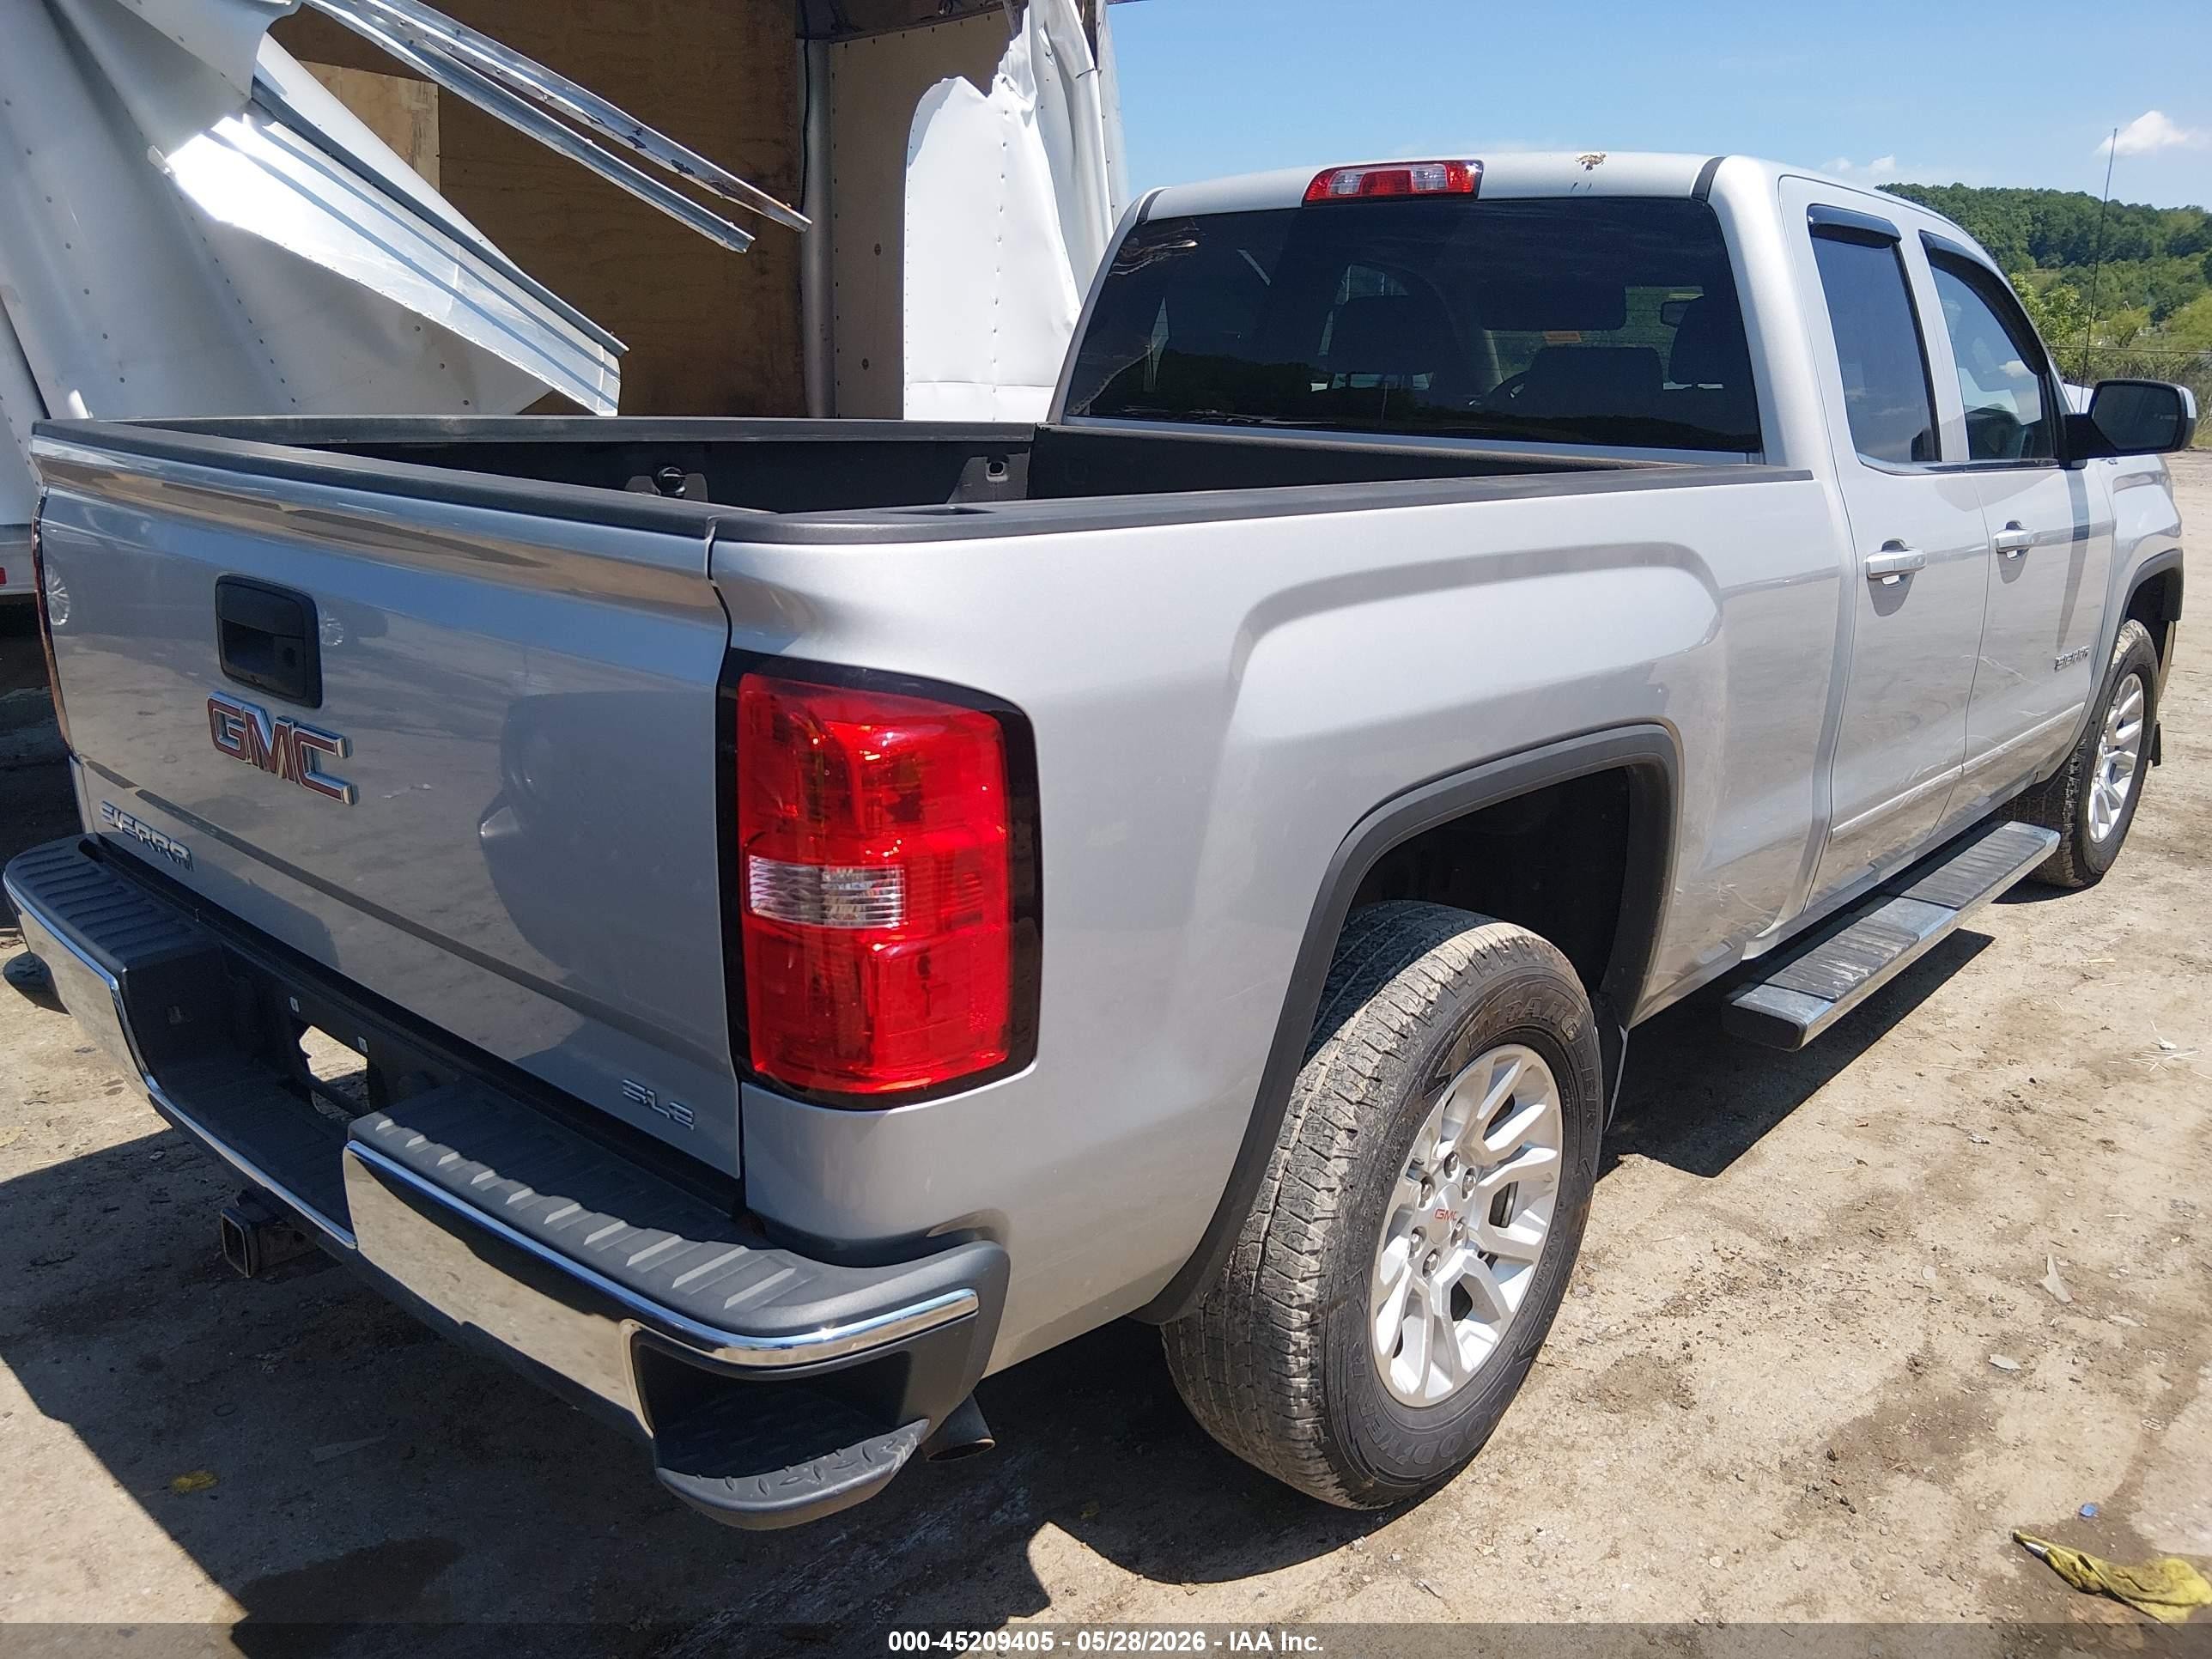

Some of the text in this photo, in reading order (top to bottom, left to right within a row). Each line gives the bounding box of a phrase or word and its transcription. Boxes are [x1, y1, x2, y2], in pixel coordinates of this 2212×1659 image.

[206, 690, 358, 805] GMC
[100, 800, 193, 872] SIERRA
[1435, 1208, 1458, 1221] GMC
